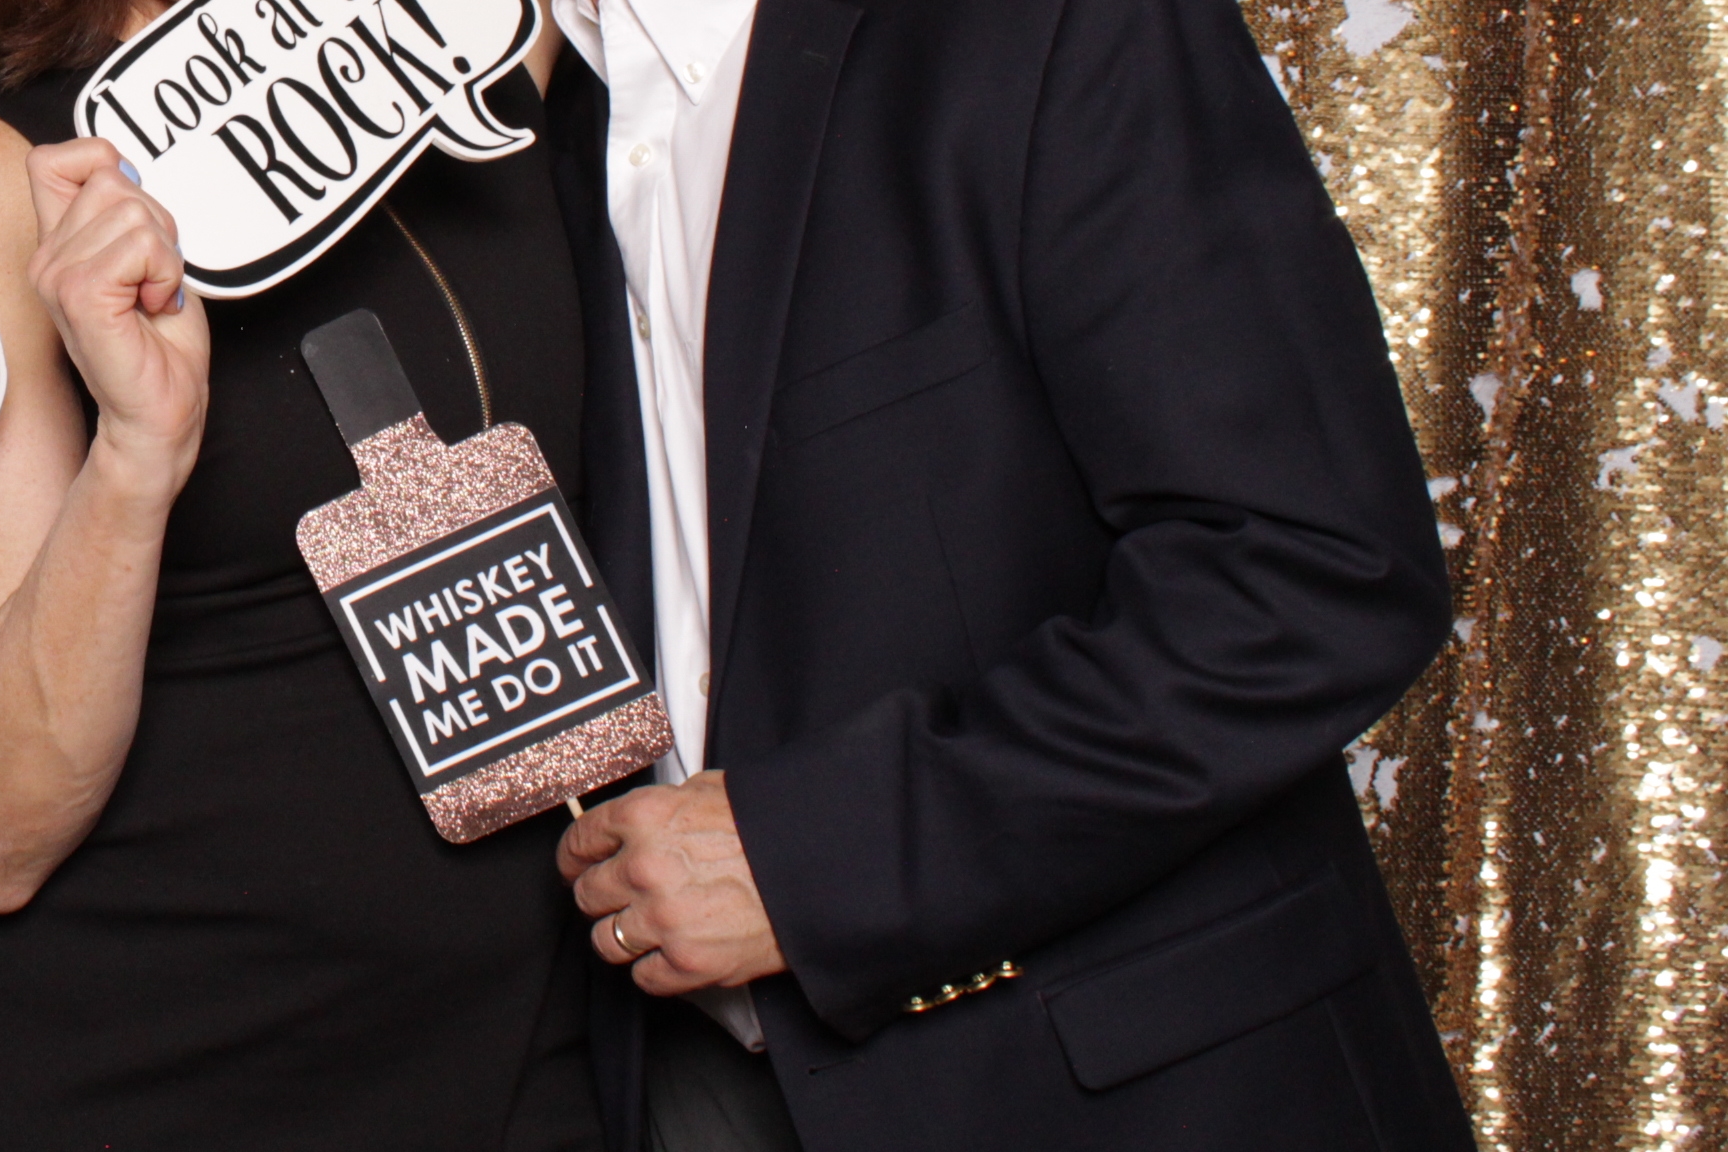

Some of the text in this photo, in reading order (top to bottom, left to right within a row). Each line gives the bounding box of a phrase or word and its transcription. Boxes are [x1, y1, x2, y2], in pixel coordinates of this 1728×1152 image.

[96, 12, 267, 163] Look
[372, 541, 557, 651] WHISKEY
[401, 583, 586, 705] MADE
[422, 634, 604, 746] ME DO IT
